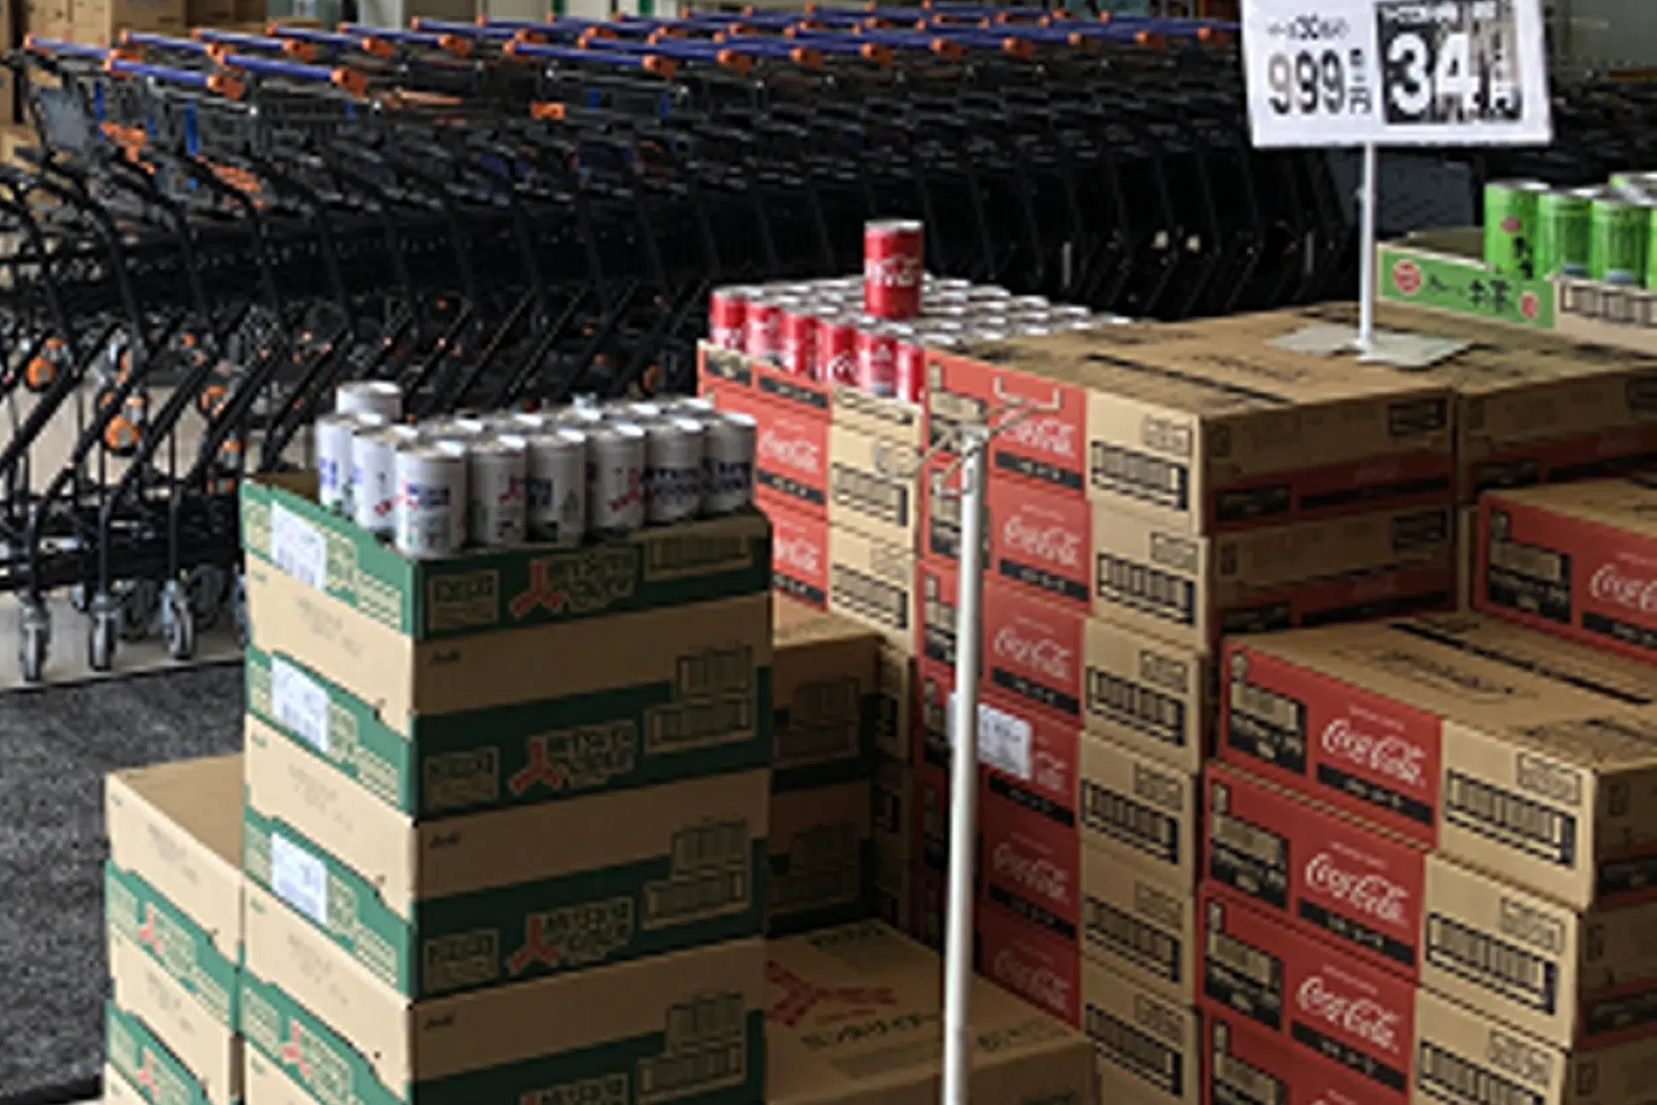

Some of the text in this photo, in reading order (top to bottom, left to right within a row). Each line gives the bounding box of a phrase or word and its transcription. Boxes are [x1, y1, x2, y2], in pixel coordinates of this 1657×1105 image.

[1267, 48, 1345, 115] 999
[1321, 716, 1428, 789] Coca-Cola
[1305, 851, 1410, 928] Coca-Cola
[1296, 975, 1400, 1055] Coca-Cola
